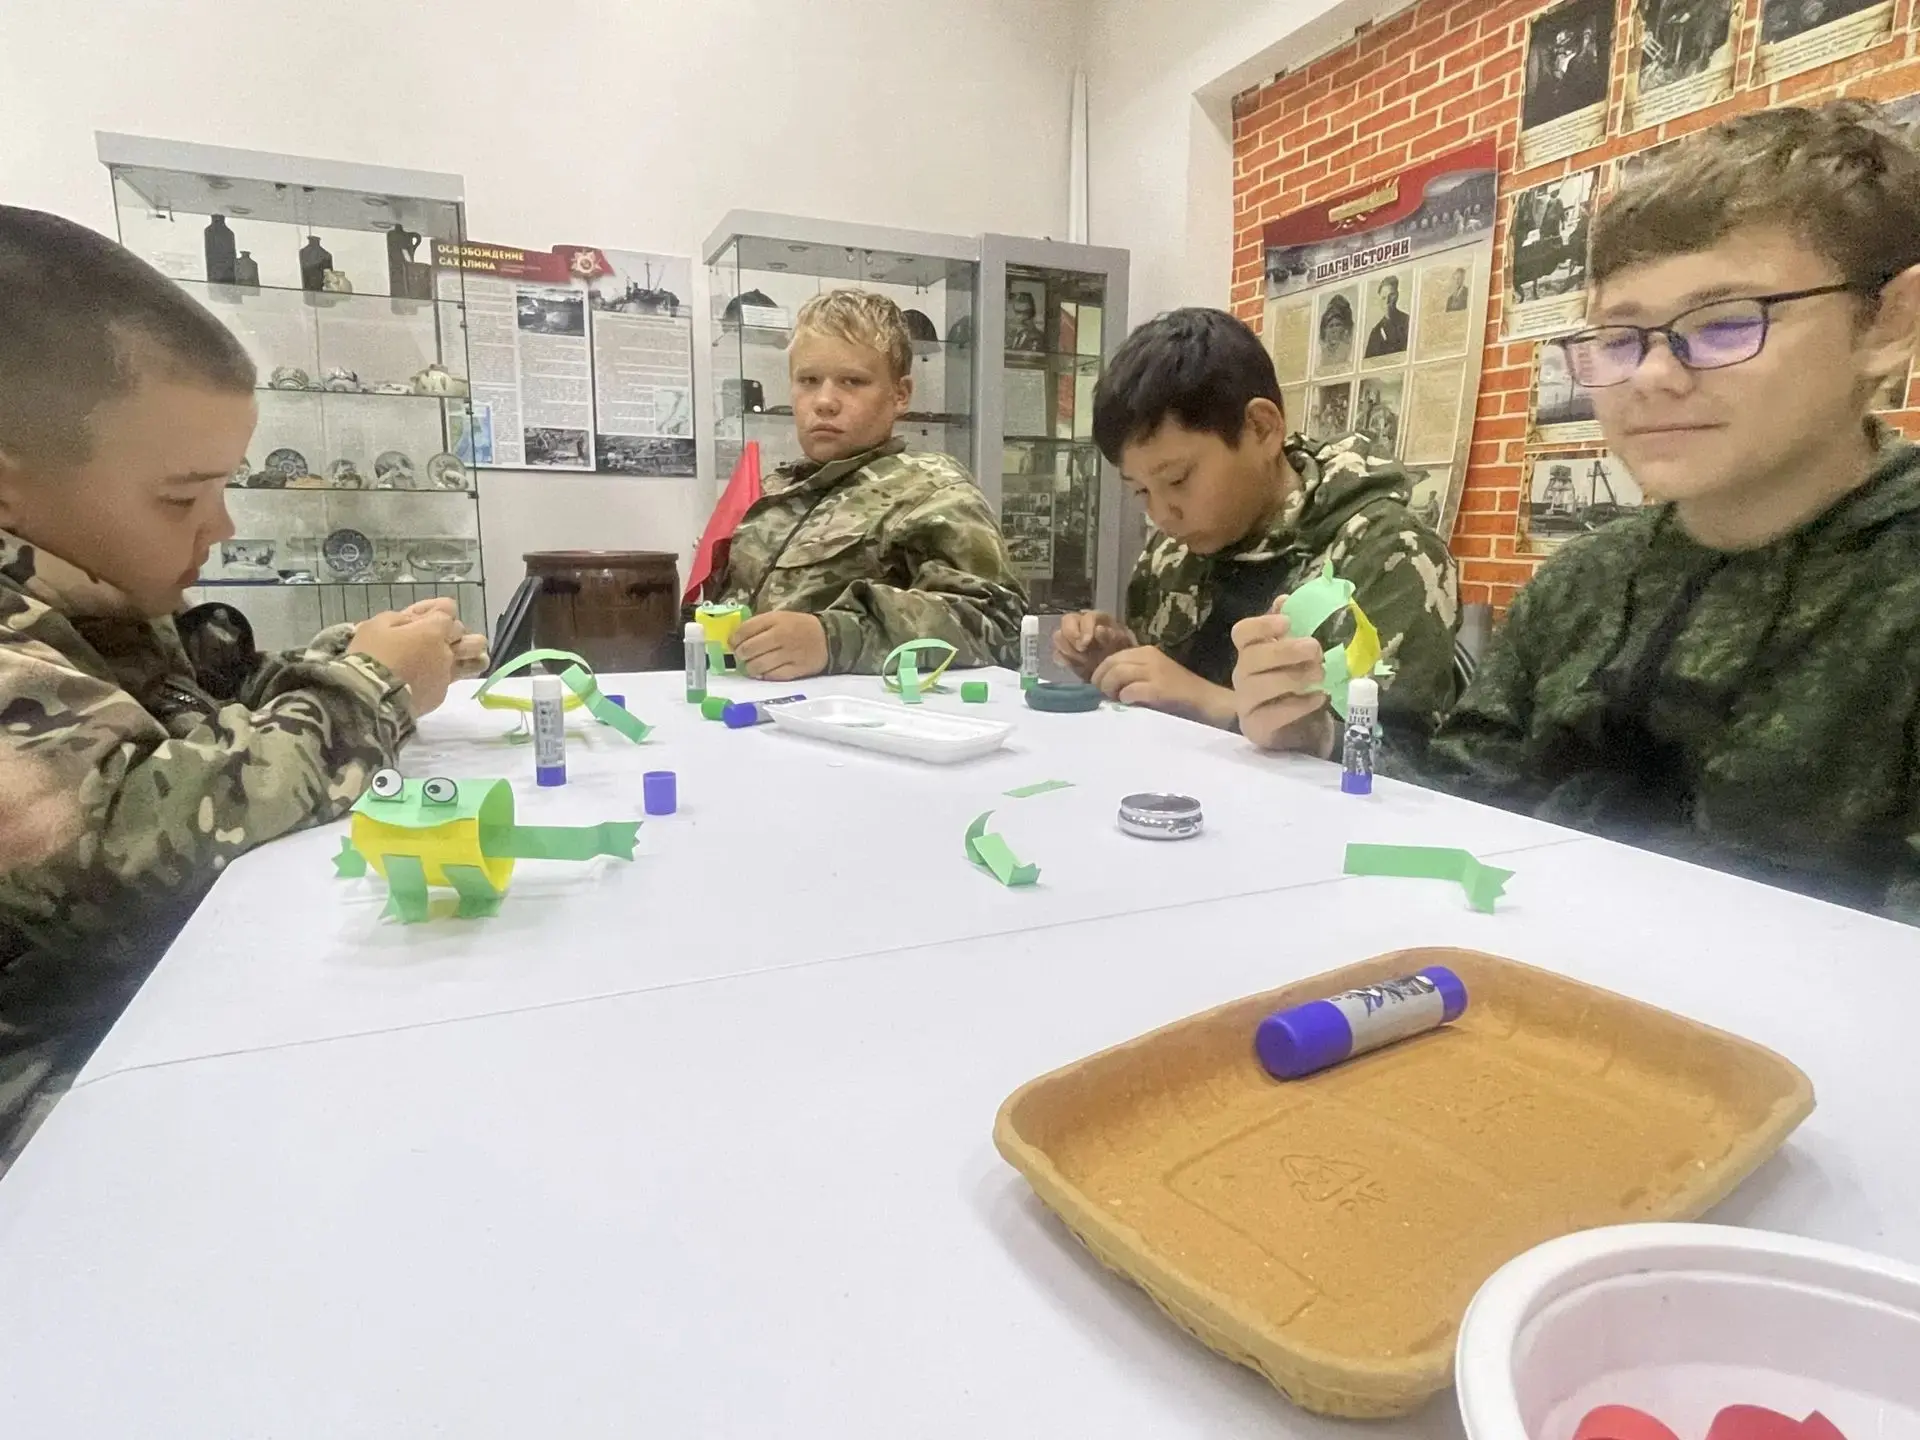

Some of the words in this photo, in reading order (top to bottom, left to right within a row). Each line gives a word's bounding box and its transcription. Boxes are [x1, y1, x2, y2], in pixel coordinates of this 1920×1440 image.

[437, 244, 525, 261] ОСВОБОЖДЕНИЕ
[1316, 257, 1349, 279] ШАГИ
[1353, 238, 1410, 269] ИСТОРИИ
[438, 257, 496, 270] САХАЛИНА
